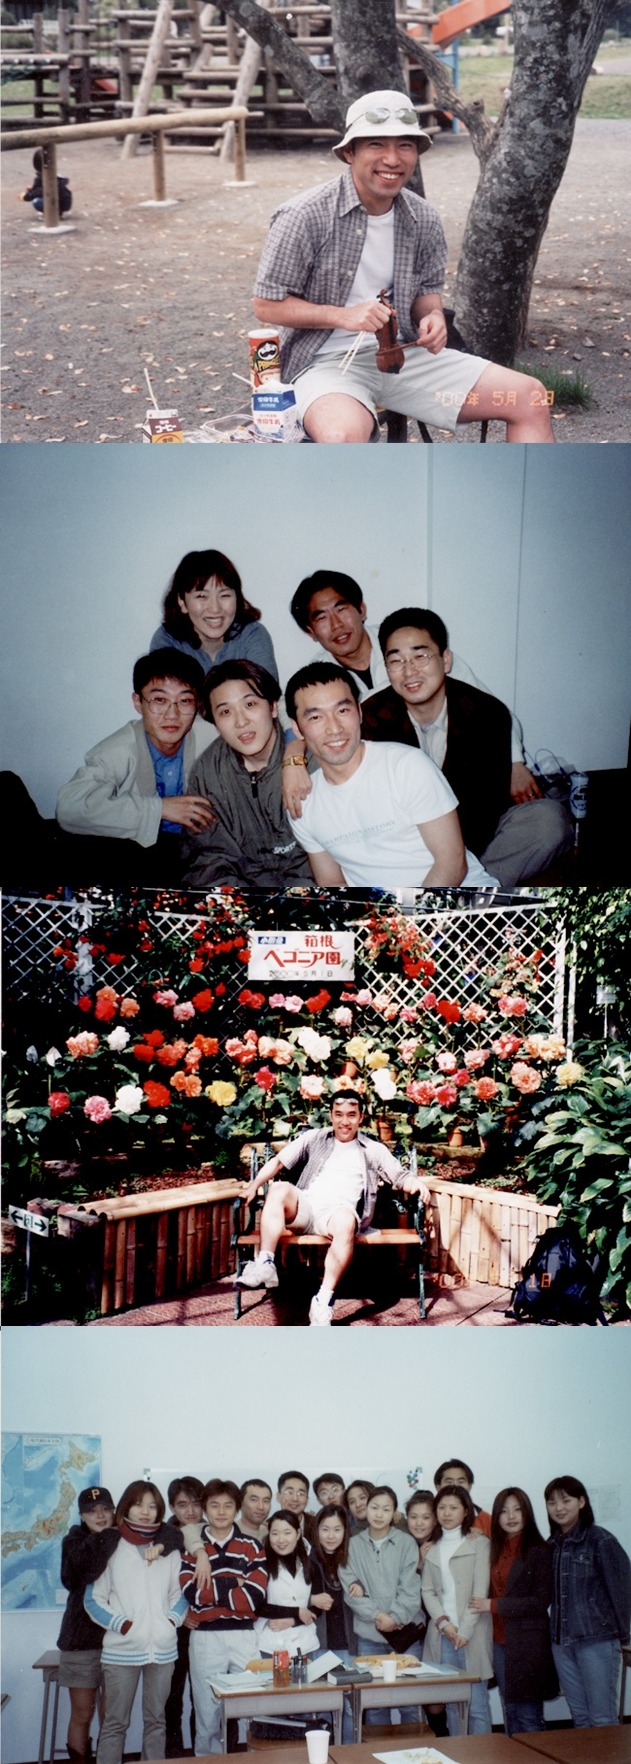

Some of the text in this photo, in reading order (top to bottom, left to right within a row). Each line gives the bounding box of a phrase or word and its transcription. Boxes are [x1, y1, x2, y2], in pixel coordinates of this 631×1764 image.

[154, 425, 177, 434] コーヒー
[304, 934, 343, 949] 箱根
[91, 1489, 100, 1500] P
